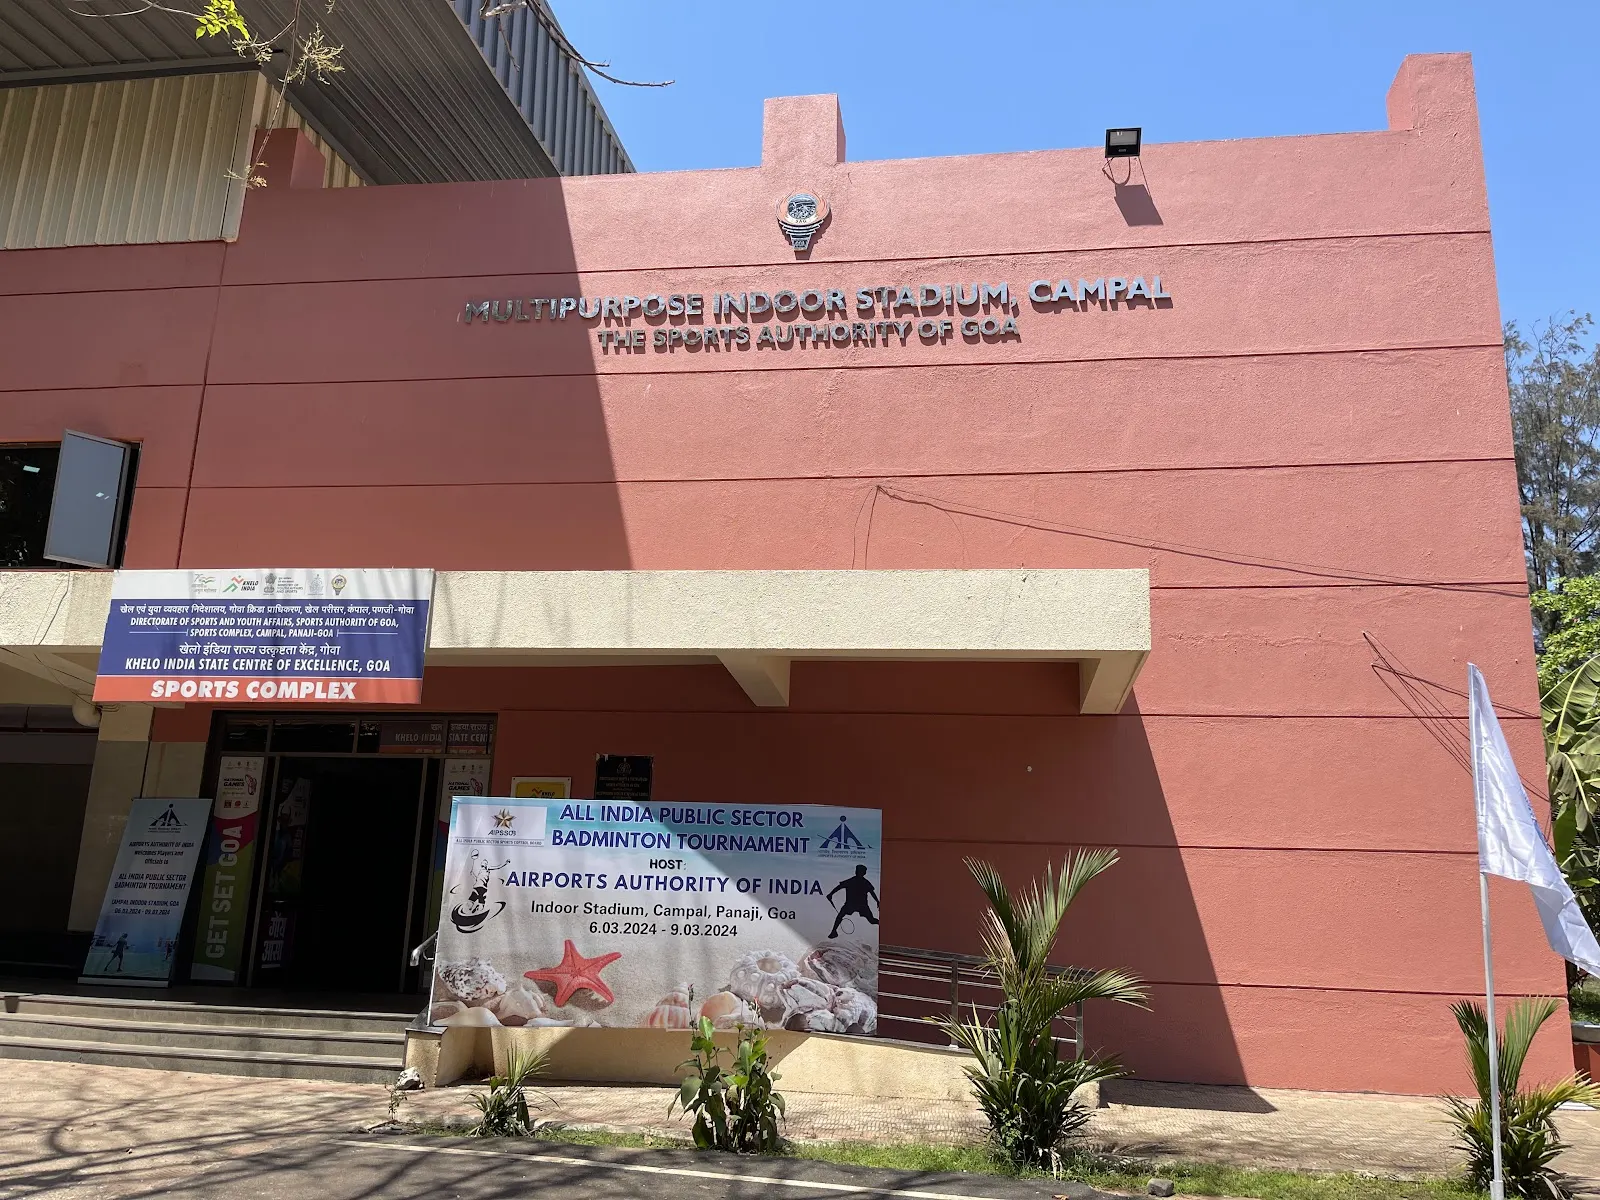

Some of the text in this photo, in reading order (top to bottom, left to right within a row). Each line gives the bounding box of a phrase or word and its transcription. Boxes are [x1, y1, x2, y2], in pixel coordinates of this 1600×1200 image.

[464, 276, 1172, 324] MULTIPURPOSE INDOOR STADIUM, CAMPAL
[597, 316, 1019, 348] THE SPORTS AUTHORITY OF GOA
[120, 604, 134, 613] खेल
[137, 604, 146, 613] एवं
[148, 605, 161, 615] युवा
[164, 605, 190, 614] व्यवहार
[229, 604, 244, 614] गोवा
[304, 604, 319, 614] खेल
[130, 618, 399, 629] DIRECTORATE OF SPORTS AND YOUTH AFFAIRS, SPORTS AUTHORITY OF GOA,
[190, 628, 334, 639] SPORTS COMPLEX, CAMPAL, PANAJI-GOA
[179, 642, 201, 655] खेलो
[203, 642, 232, 656] इंडिया
[233, 645, 256, 655] राज्य
[319, 643, 341, 656] गोवा
[125, 658, 391, 673] KHELO INDIA STATE CENTRE OF EXCELLENCE, GOA
[151, 680, 357, 700] SPORTS COMPLEX
[395, 733, 419, 742] KHELO
[559, 804, 804, 828] ALL INDIA PUBLIC SECTOR
[217, 825, 243, 868] GOA
[552, 829, 810, 854] BADMINTON TOURNAMENT
[649, 859, 687, 872] HOST:
[211, 871, 236, 913] SET
[505, 871, 824, 896] AIRPORTS AUTHORITY OF INDIA
[530, 900, 796, 922] Indoor Stadium, Campal, Panaji, Goa
[205, 915, 230, 960] GET
[589, 921, 657, 936] 6.03.2024
[670, 923, 738, 938] 9.03.2024
